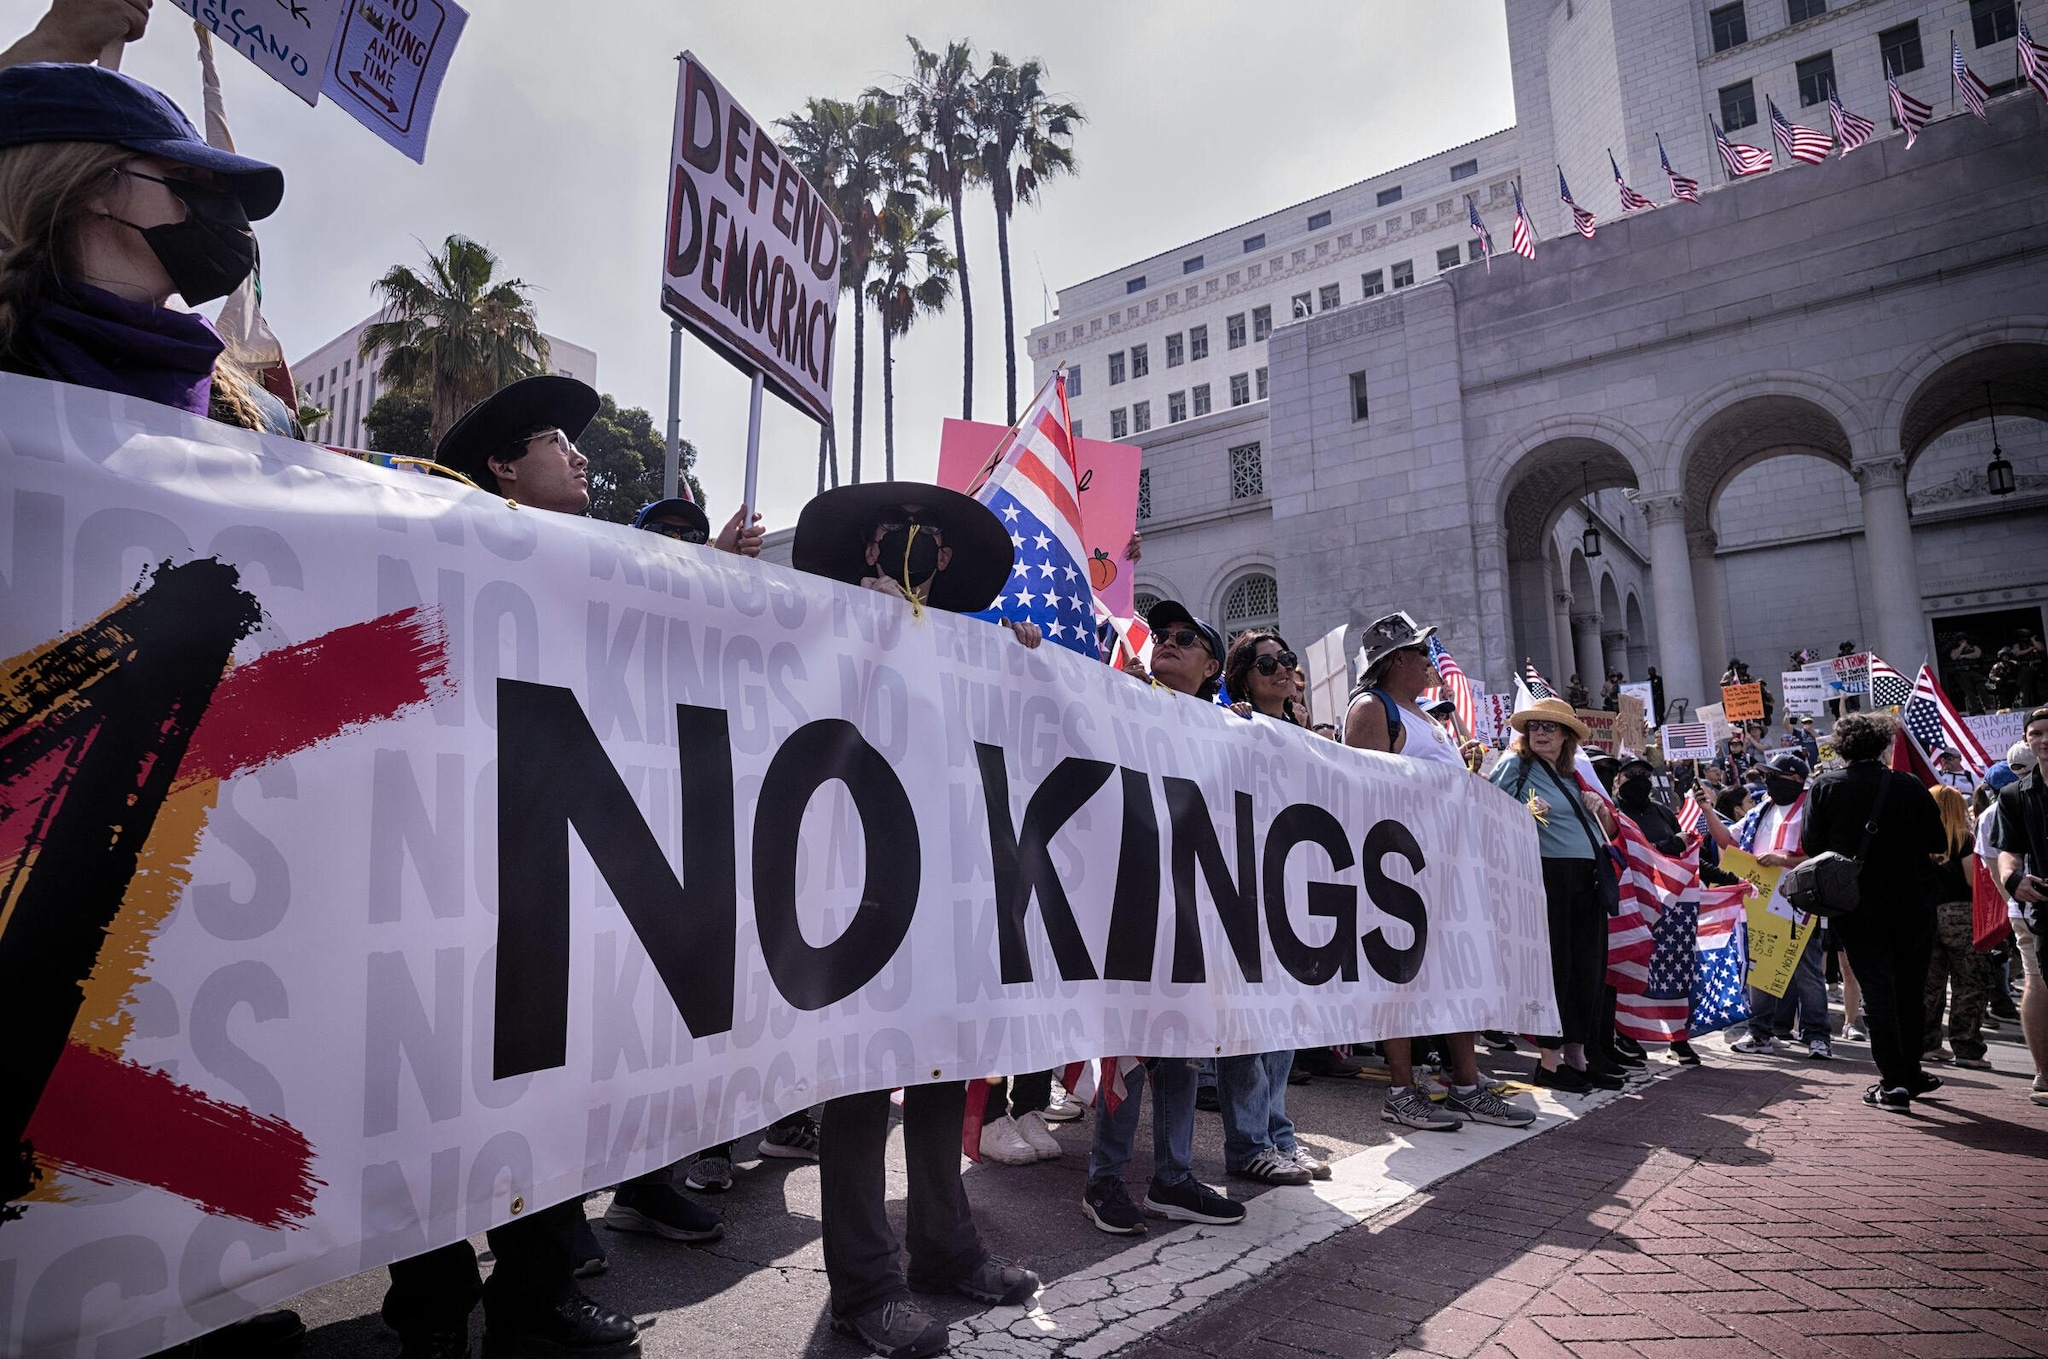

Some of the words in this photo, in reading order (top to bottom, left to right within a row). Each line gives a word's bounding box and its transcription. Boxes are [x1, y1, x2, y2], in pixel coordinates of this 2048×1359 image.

[384, 0, 418, 21] O
[367, 37, 400, 70] ANY
[385, 16, 426, 67] KING
[363, 52, 396, 94] TIME
[681, 60, 840, 280] DEFEND
[667, 163, 837, 392] DEMOCRACY
[377, 552, 539, 730] NO
[586, 599, 810, 756] KINGS
[838, 654, 909, 767] NO
[939, 671, 1096, 785] KINGS
[1842, 681, 1870, 692] THIS
[1578, 716, 1613, 730] TRUMP
[1982, 724, 2023, 741] HOME
[493, 678, 921, 1081] NO
[973, 740, 1429, 986] KINGS
[1438, 929, 1483, 990] NO
